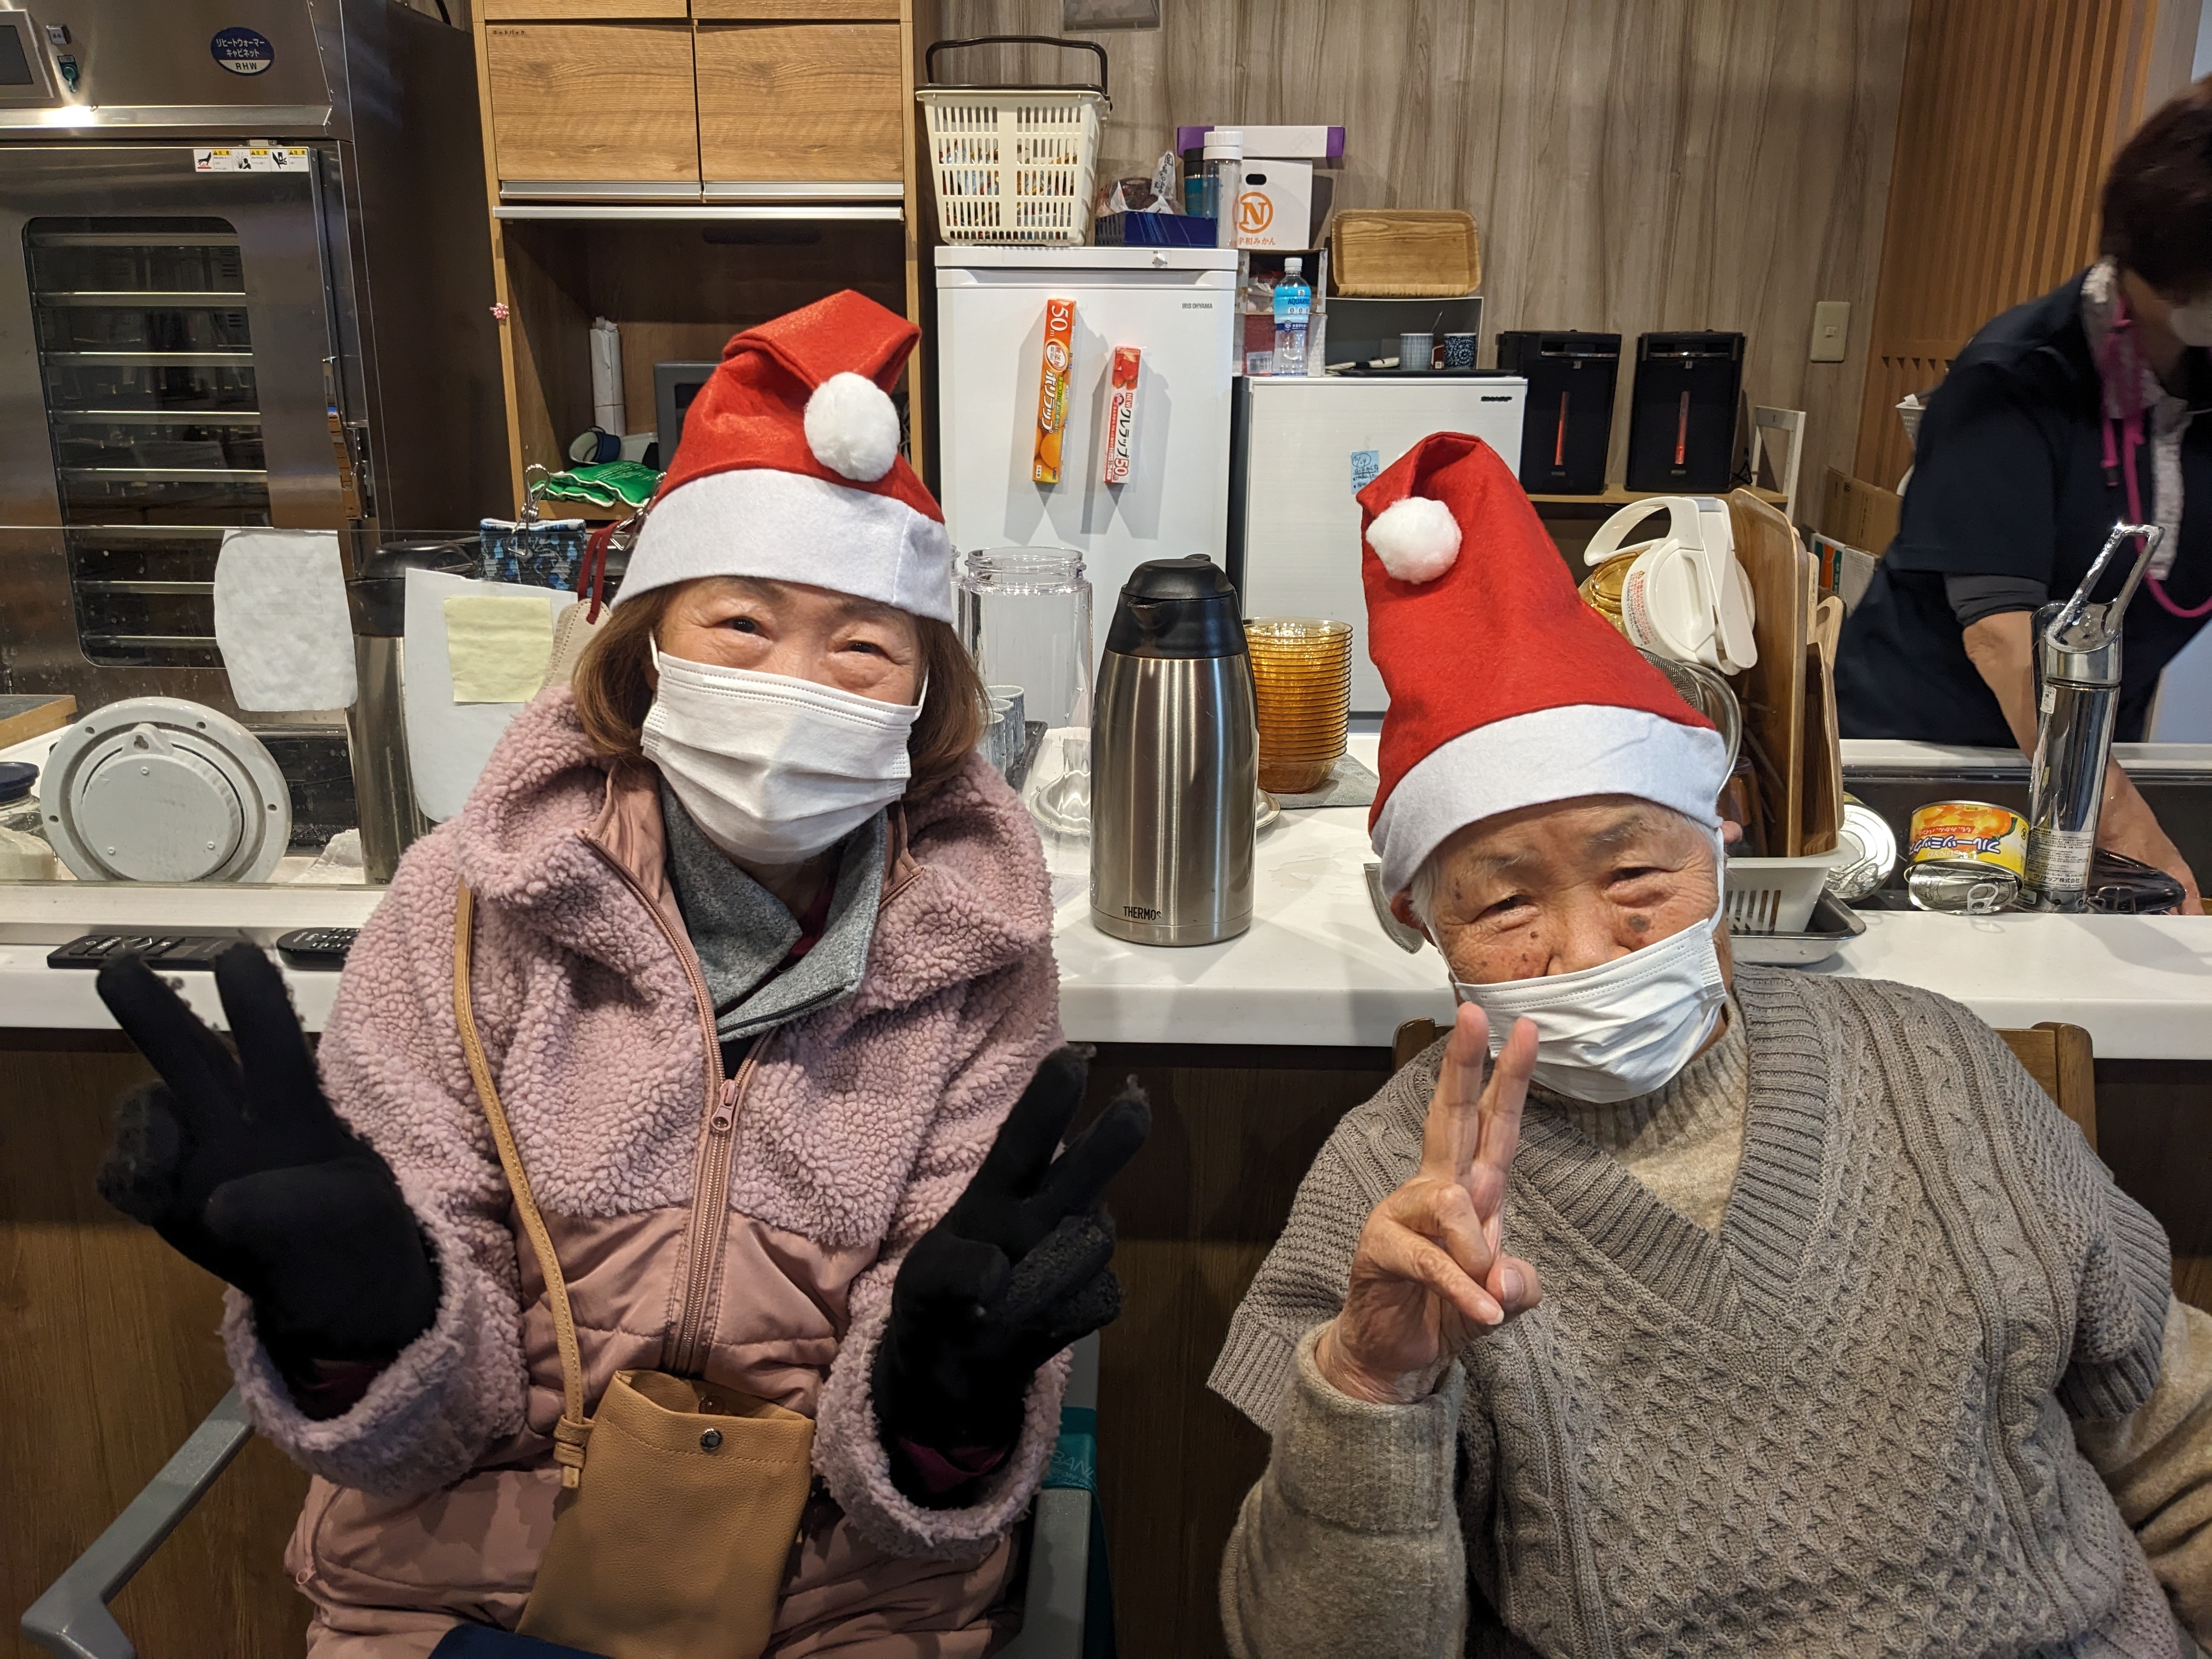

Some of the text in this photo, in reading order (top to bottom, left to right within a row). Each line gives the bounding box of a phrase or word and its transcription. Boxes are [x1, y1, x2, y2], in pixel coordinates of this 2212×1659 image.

[216, 38, 265, 47] リヒートウォーマー
[225, 48, 260, 57] キャビネット
[235, 62, 257, 70] RHW
[1241, 202, 1268, 225] N
[1042, 369, 1058, 434] ポリラップ
[1117, 409, 1131, 459] クレラップ
[1909, 835, 2001, 855] フルーツミックス
[2033, 874, 2080, 883] クリナップ株式会社
[1123, 906, 1161, 921] THERMOS
